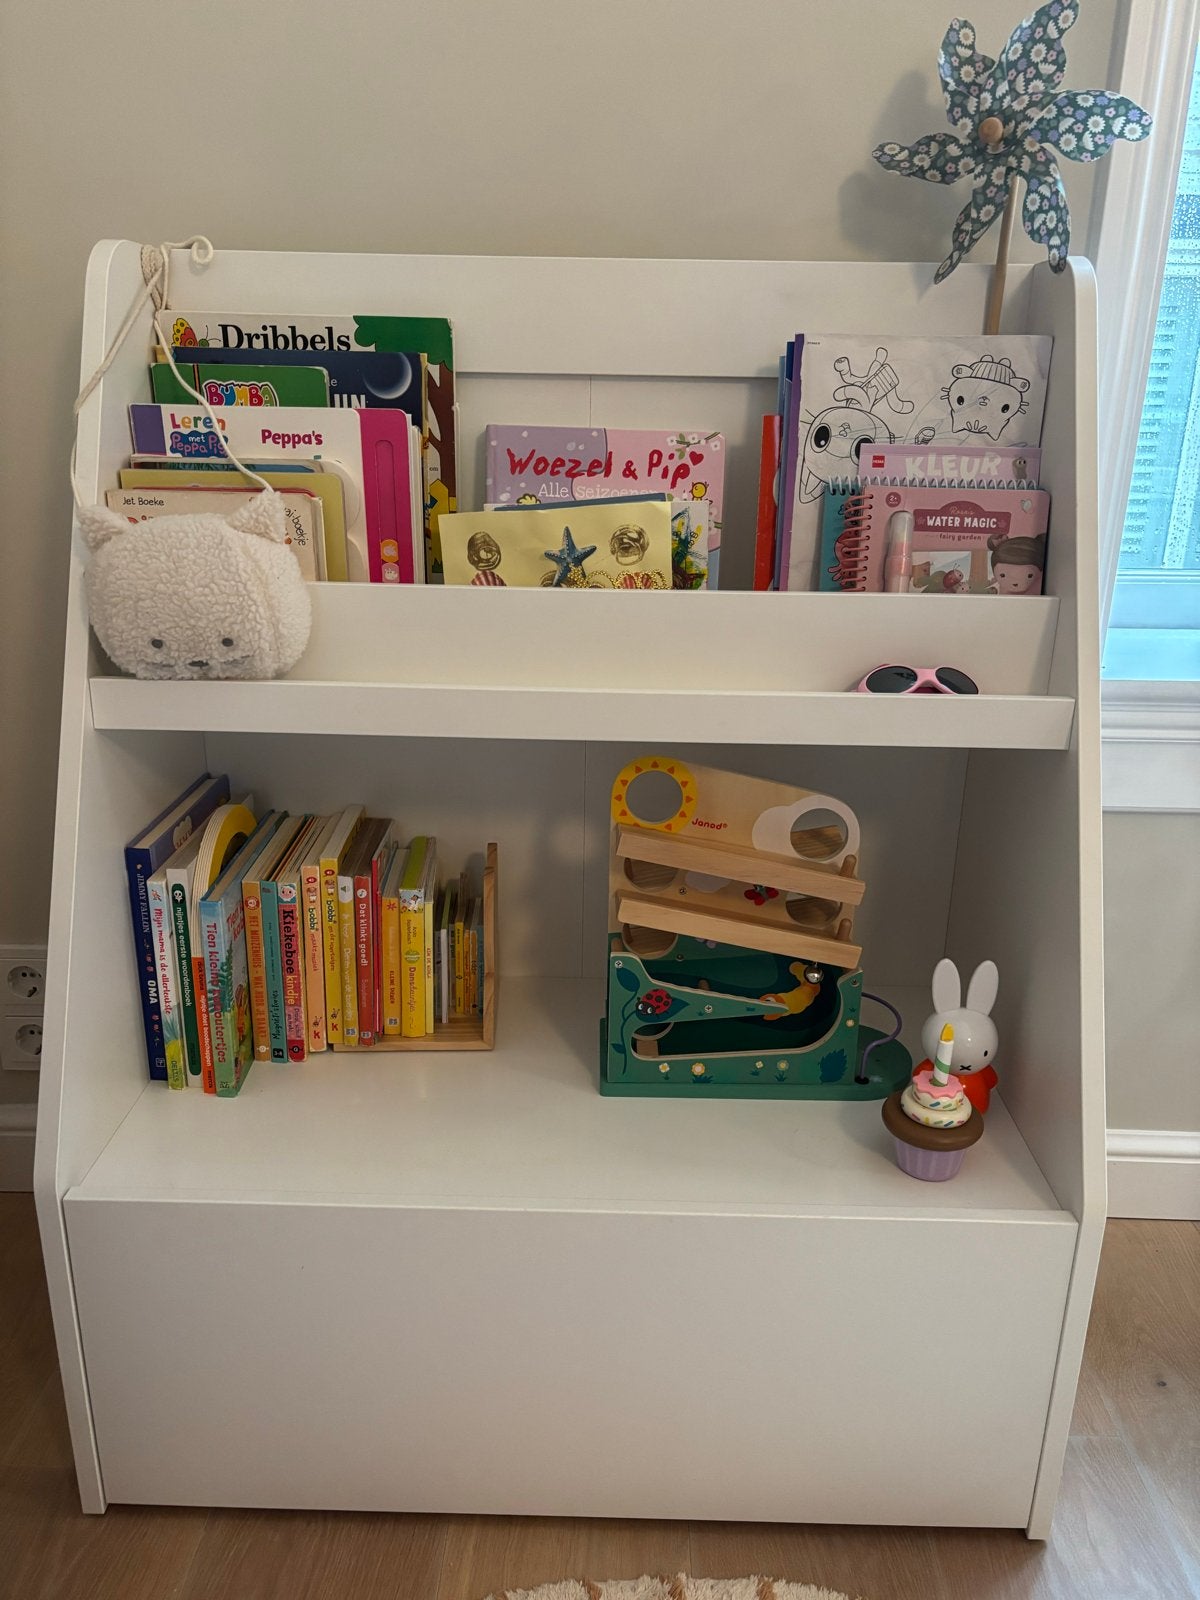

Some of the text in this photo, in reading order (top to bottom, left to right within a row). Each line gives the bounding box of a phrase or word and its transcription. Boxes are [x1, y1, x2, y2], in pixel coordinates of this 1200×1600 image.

[218, 324, 351, 351] Dribbels
[205, 383, 277, 407] BUMBA
[170, 413, 226, 430] Leren
[171, 433, 207, 455] Peppa
[189, 434, 205, 442] met
[261, 428, 323, 448] Peppa's
[506, 448, 691, 489] Woezel & Pip
[906, 452, 1001, 481] KLEUR
[538, 482, 569, 497] Alle
[123, 497, 164, 506] Jet Boeke
[926, 516, 997, 528] WATER MAGIC
[939, 533, 955, 541] fairy
[137, 873, 150, 933] JIMMY FALLON
[326, 900, 335, 923] bobbi
[359, 903, 367, 916] Dat
[308, 907, 317, 930] bobbi
[206, 922, 218, 948] Tien
[160, 962, 168, 971] de
[176, 907, 192, 1006] nijntjes eerste woordenboek
[283, 909, 299, 1005] Kiekeboe kindje
[359, 944, 368, 966] goed!
[208, 951, 220, 986] kleine
[147, 980, 158, 1004] OMA
[203, 1026, 211, 1067] boodschappen
